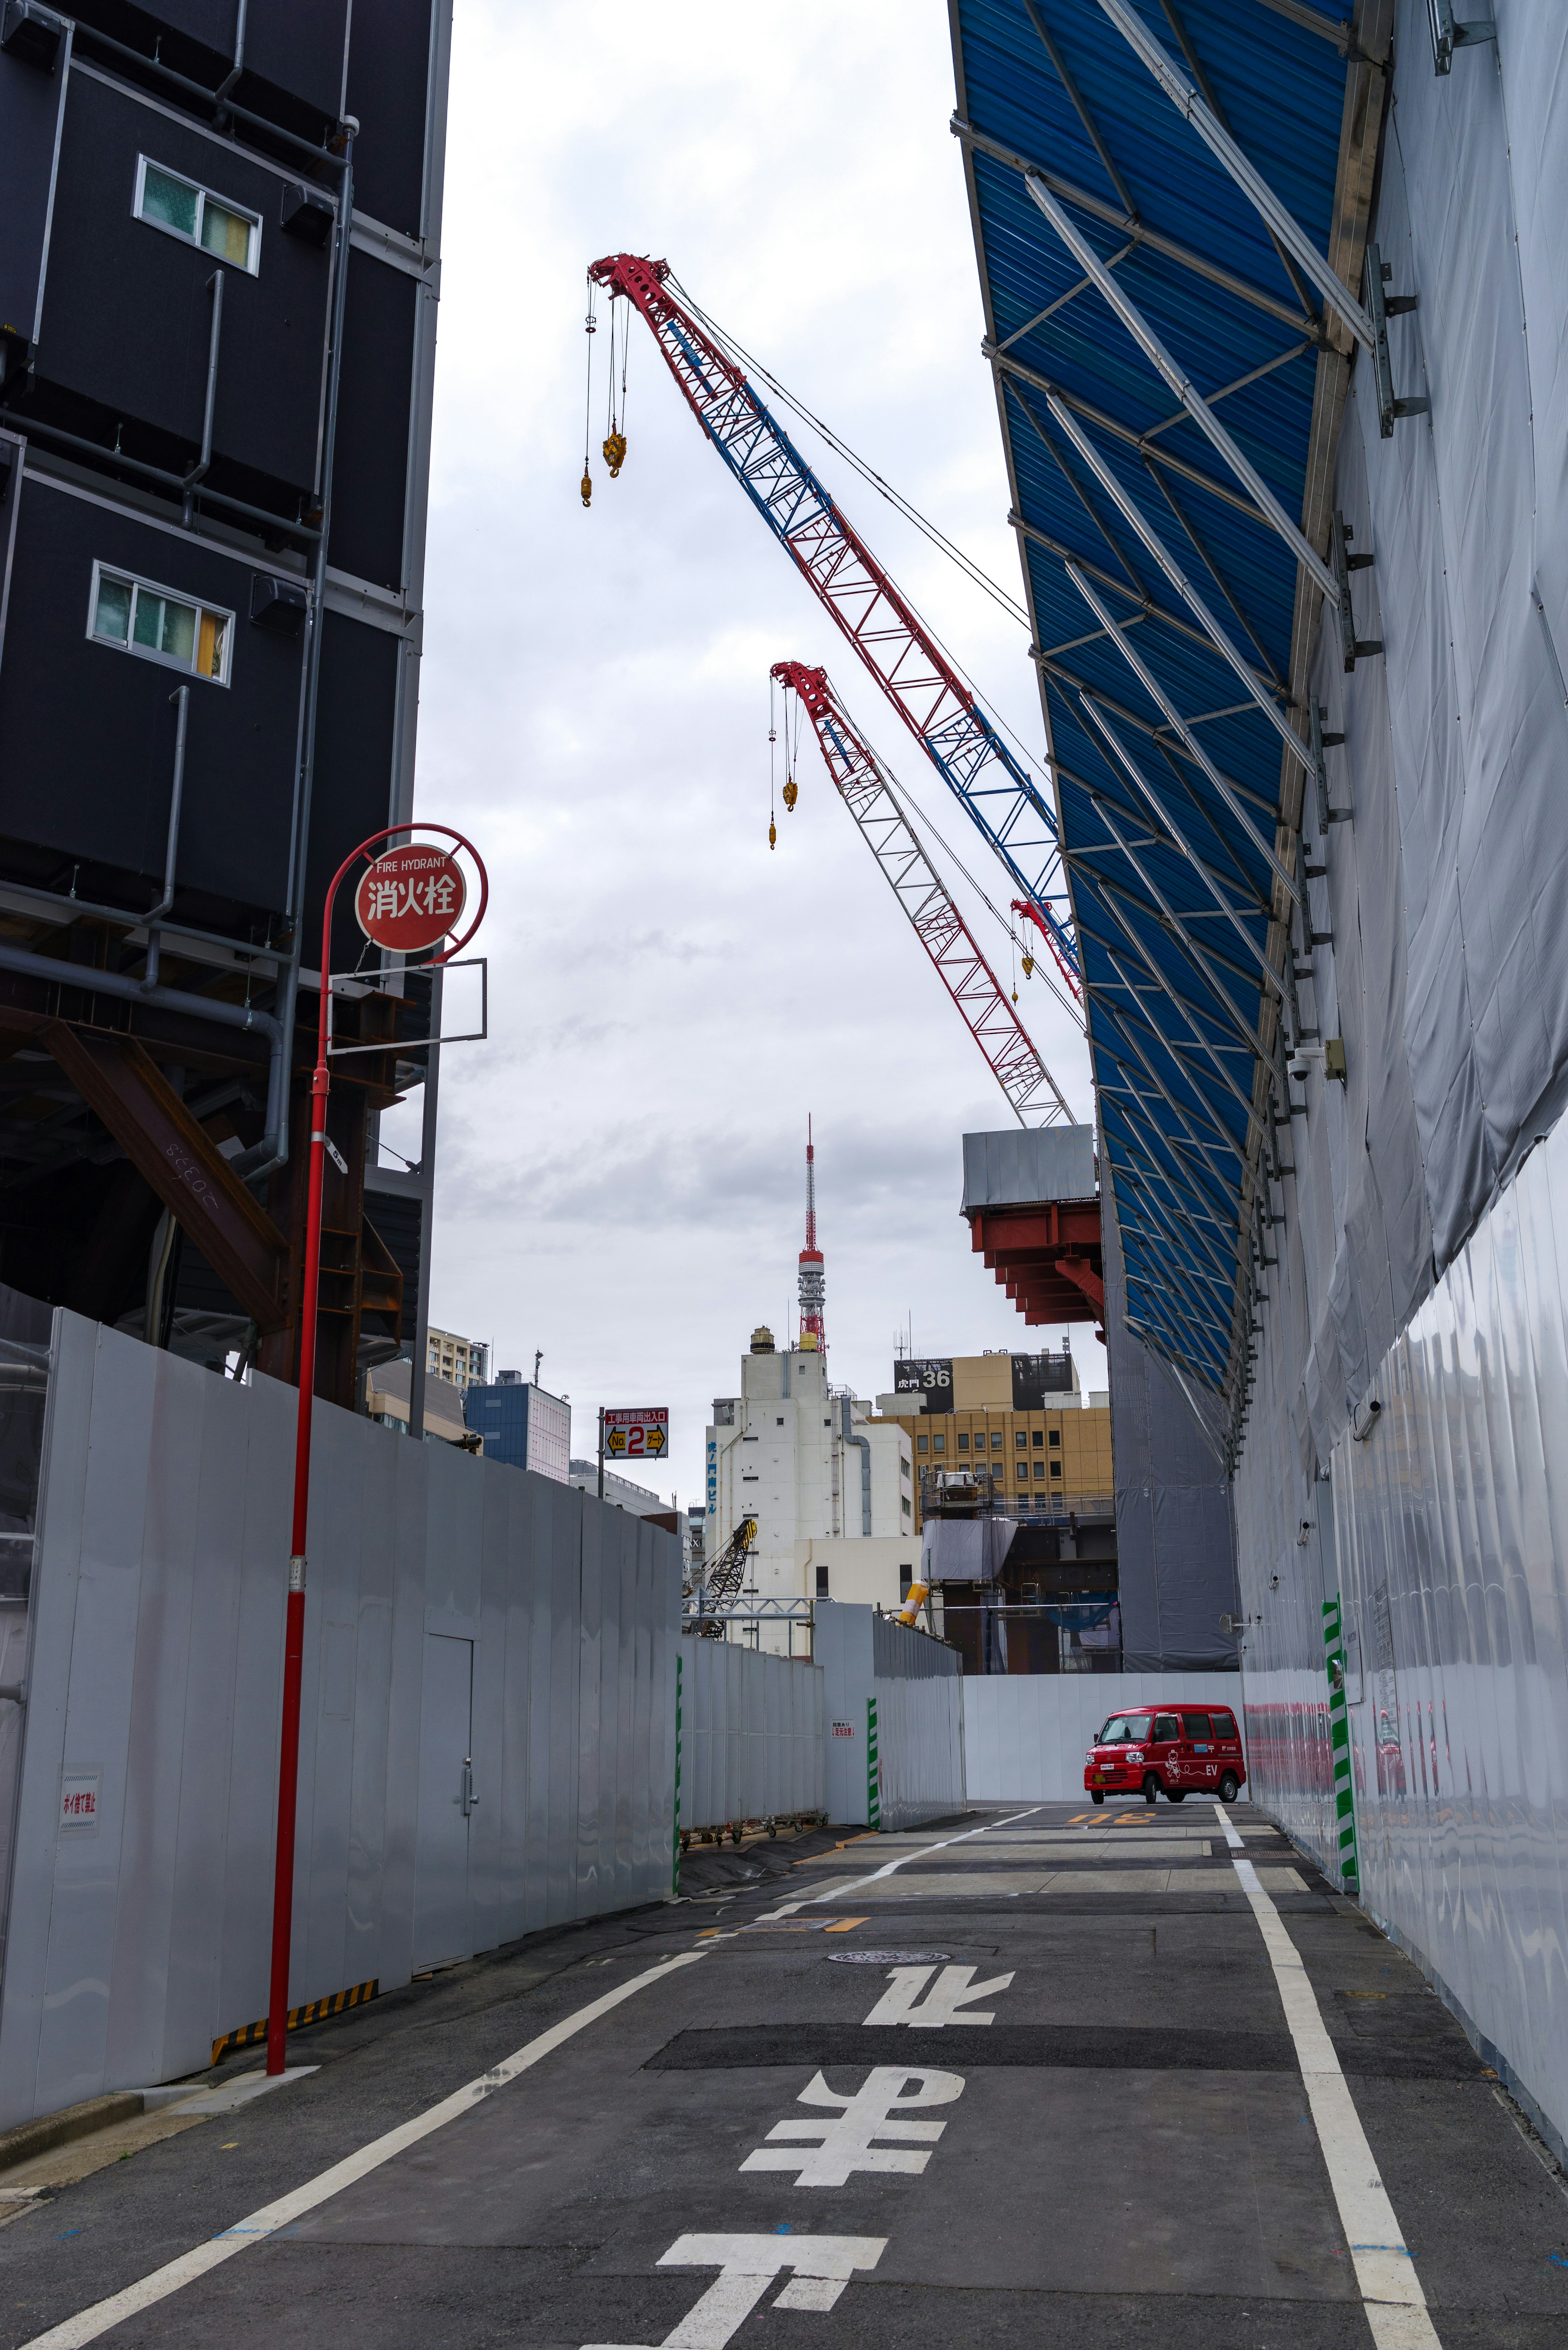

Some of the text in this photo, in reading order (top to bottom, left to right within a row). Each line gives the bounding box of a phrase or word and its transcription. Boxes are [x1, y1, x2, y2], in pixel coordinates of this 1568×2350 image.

[672, 328, 697, 361] HUMAN OHYA
[826, 724, 844, 753] HUMAN OHYA
[376, 856, 447, 873] FIRE HYDRANT
[368, 874, 456, 920] 消火栓
[898, 1370, 950, 1388] 虎門 36
[608, 1411, 665, 1424] 工事用車両出入口
[612, 1426, 662, 1454] No. 2 ゲート
[708, 1442, 717, 1514] 虎ノ門南ビル
[835, 1727, 851, 1736] 足元注意
[1206, 1764, 1217, 1776] EV
[64, 1792, 96, 1814] ポイ捨て禁止
